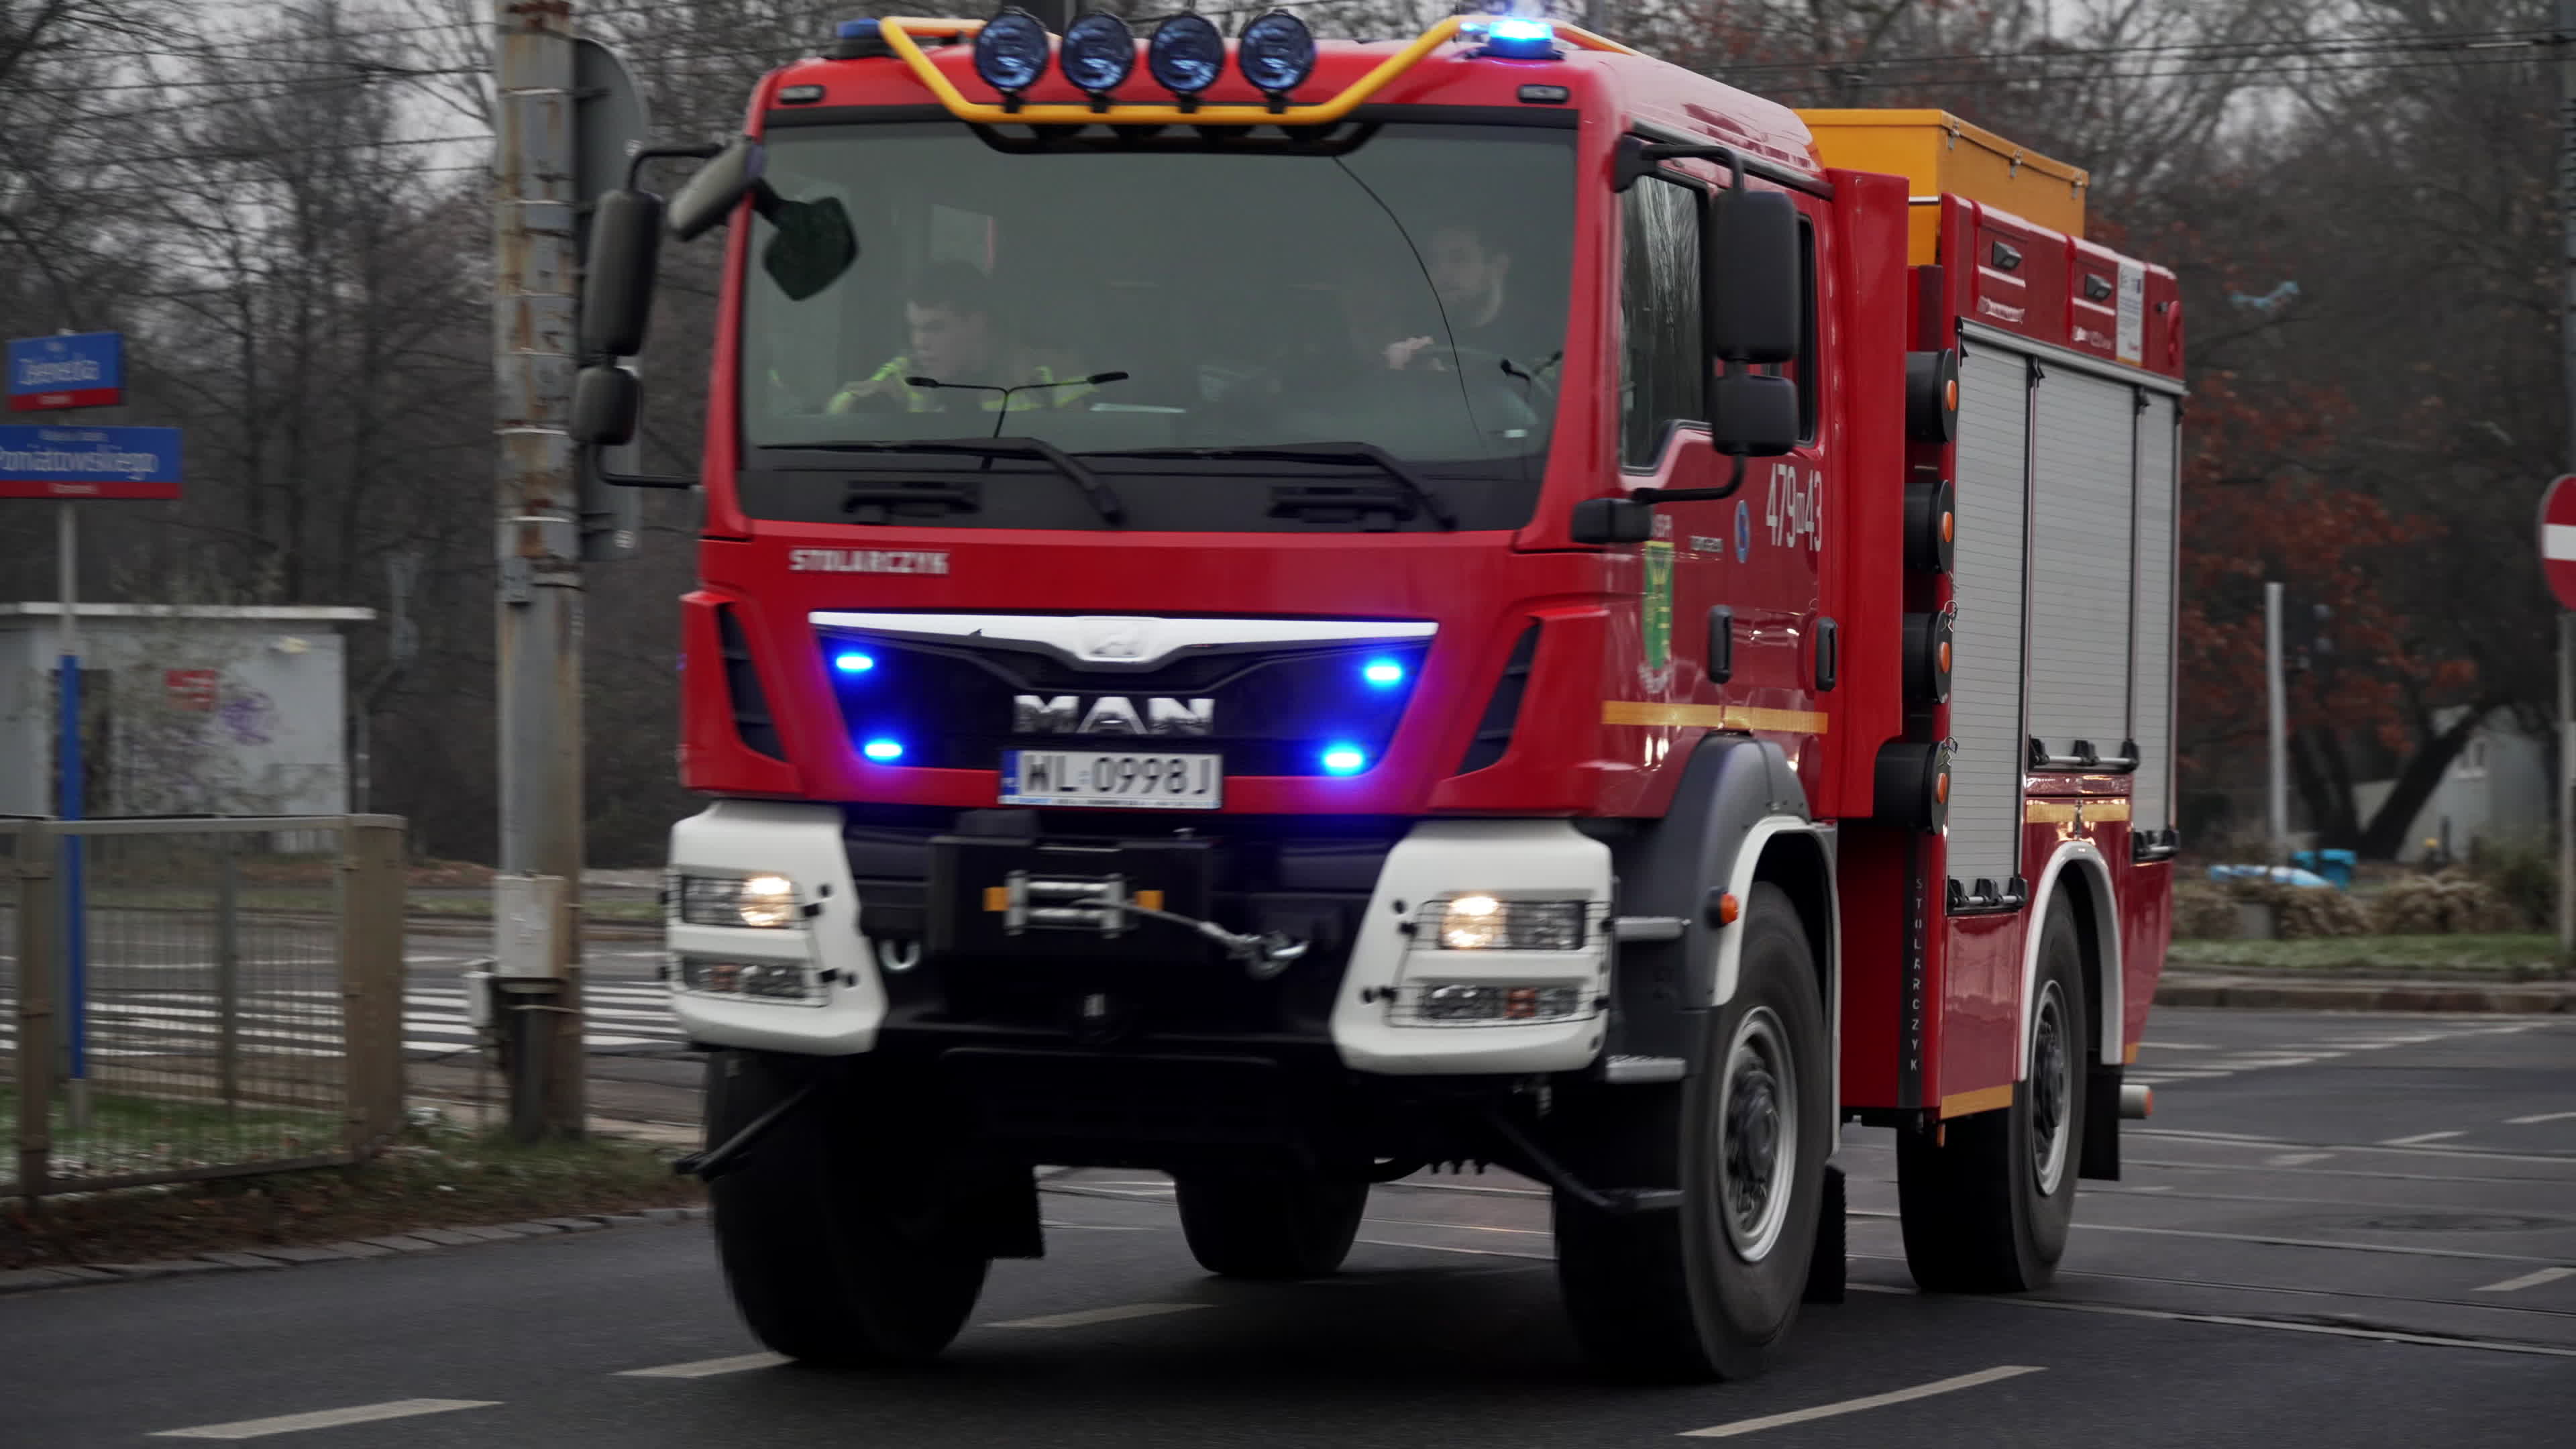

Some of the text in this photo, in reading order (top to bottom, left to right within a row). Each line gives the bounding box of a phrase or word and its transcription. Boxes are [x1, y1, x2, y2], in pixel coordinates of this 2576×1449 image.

[788, 548, 950, 575] STOLARCZYK
[1013, 694, 1216, 735] MAN
[1022, 755, 1212, 795] WL 0998J
[1910, 877, 1923, 1072] STOLARCZYK
